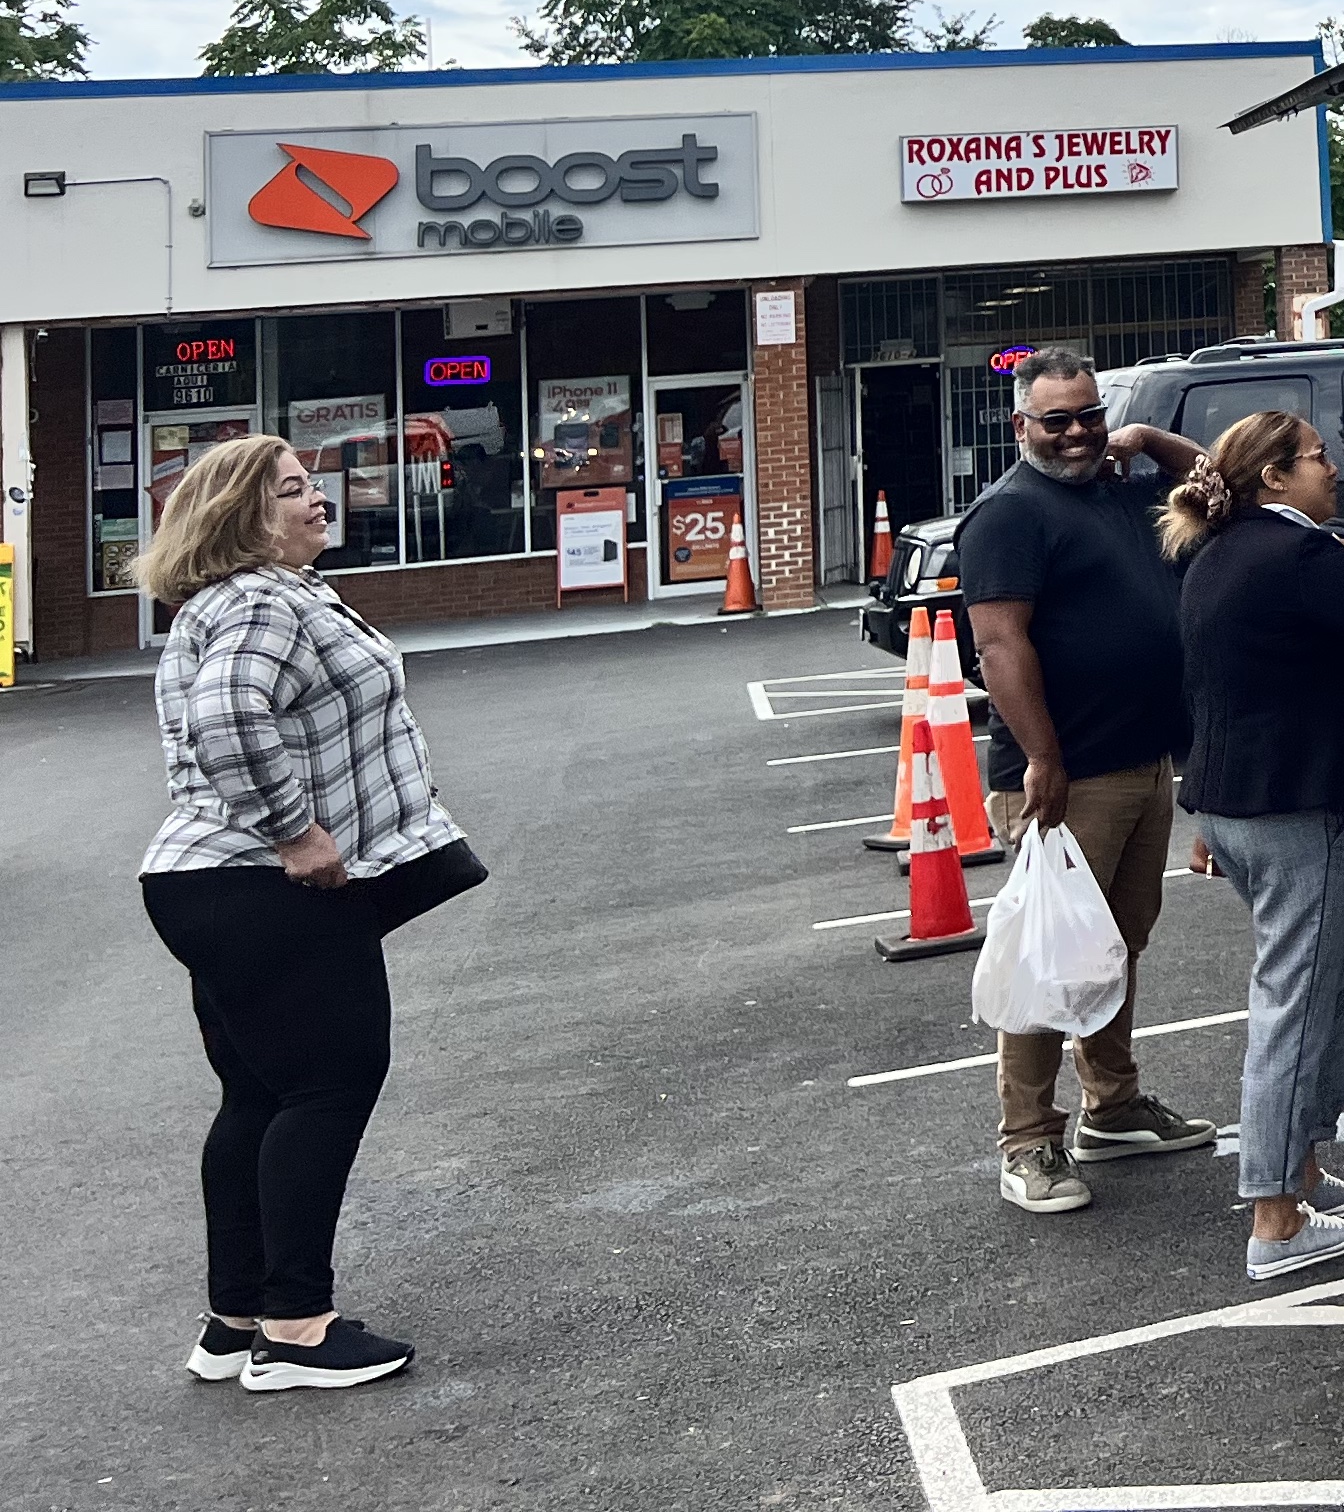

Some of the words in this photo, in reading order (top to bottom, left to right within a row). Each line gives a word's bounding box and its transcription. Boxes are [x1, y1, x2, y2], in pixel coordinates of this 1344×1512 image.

[907, 132, 1047, 165] ROXANA'S
[1054, 129, 1172, 162] JEWELRY
[415, 133, 719, 211] boost
[974, 166, 1034, 195] AND
[1044, 164, 1108, 190] PLUS
[417, 209, 584, 248] mobile
[176, 339, 236, 361] OPEN
[990, 350, 1034, 370] OPE
[156, 361, 237, 377] CARNICERIA
[430, 361, 488, 381] OPEN
[174, 387, 214, 404] 9610
[297, 402, 379, 424] GRATIS
[672, 511, 726, 541] $25
